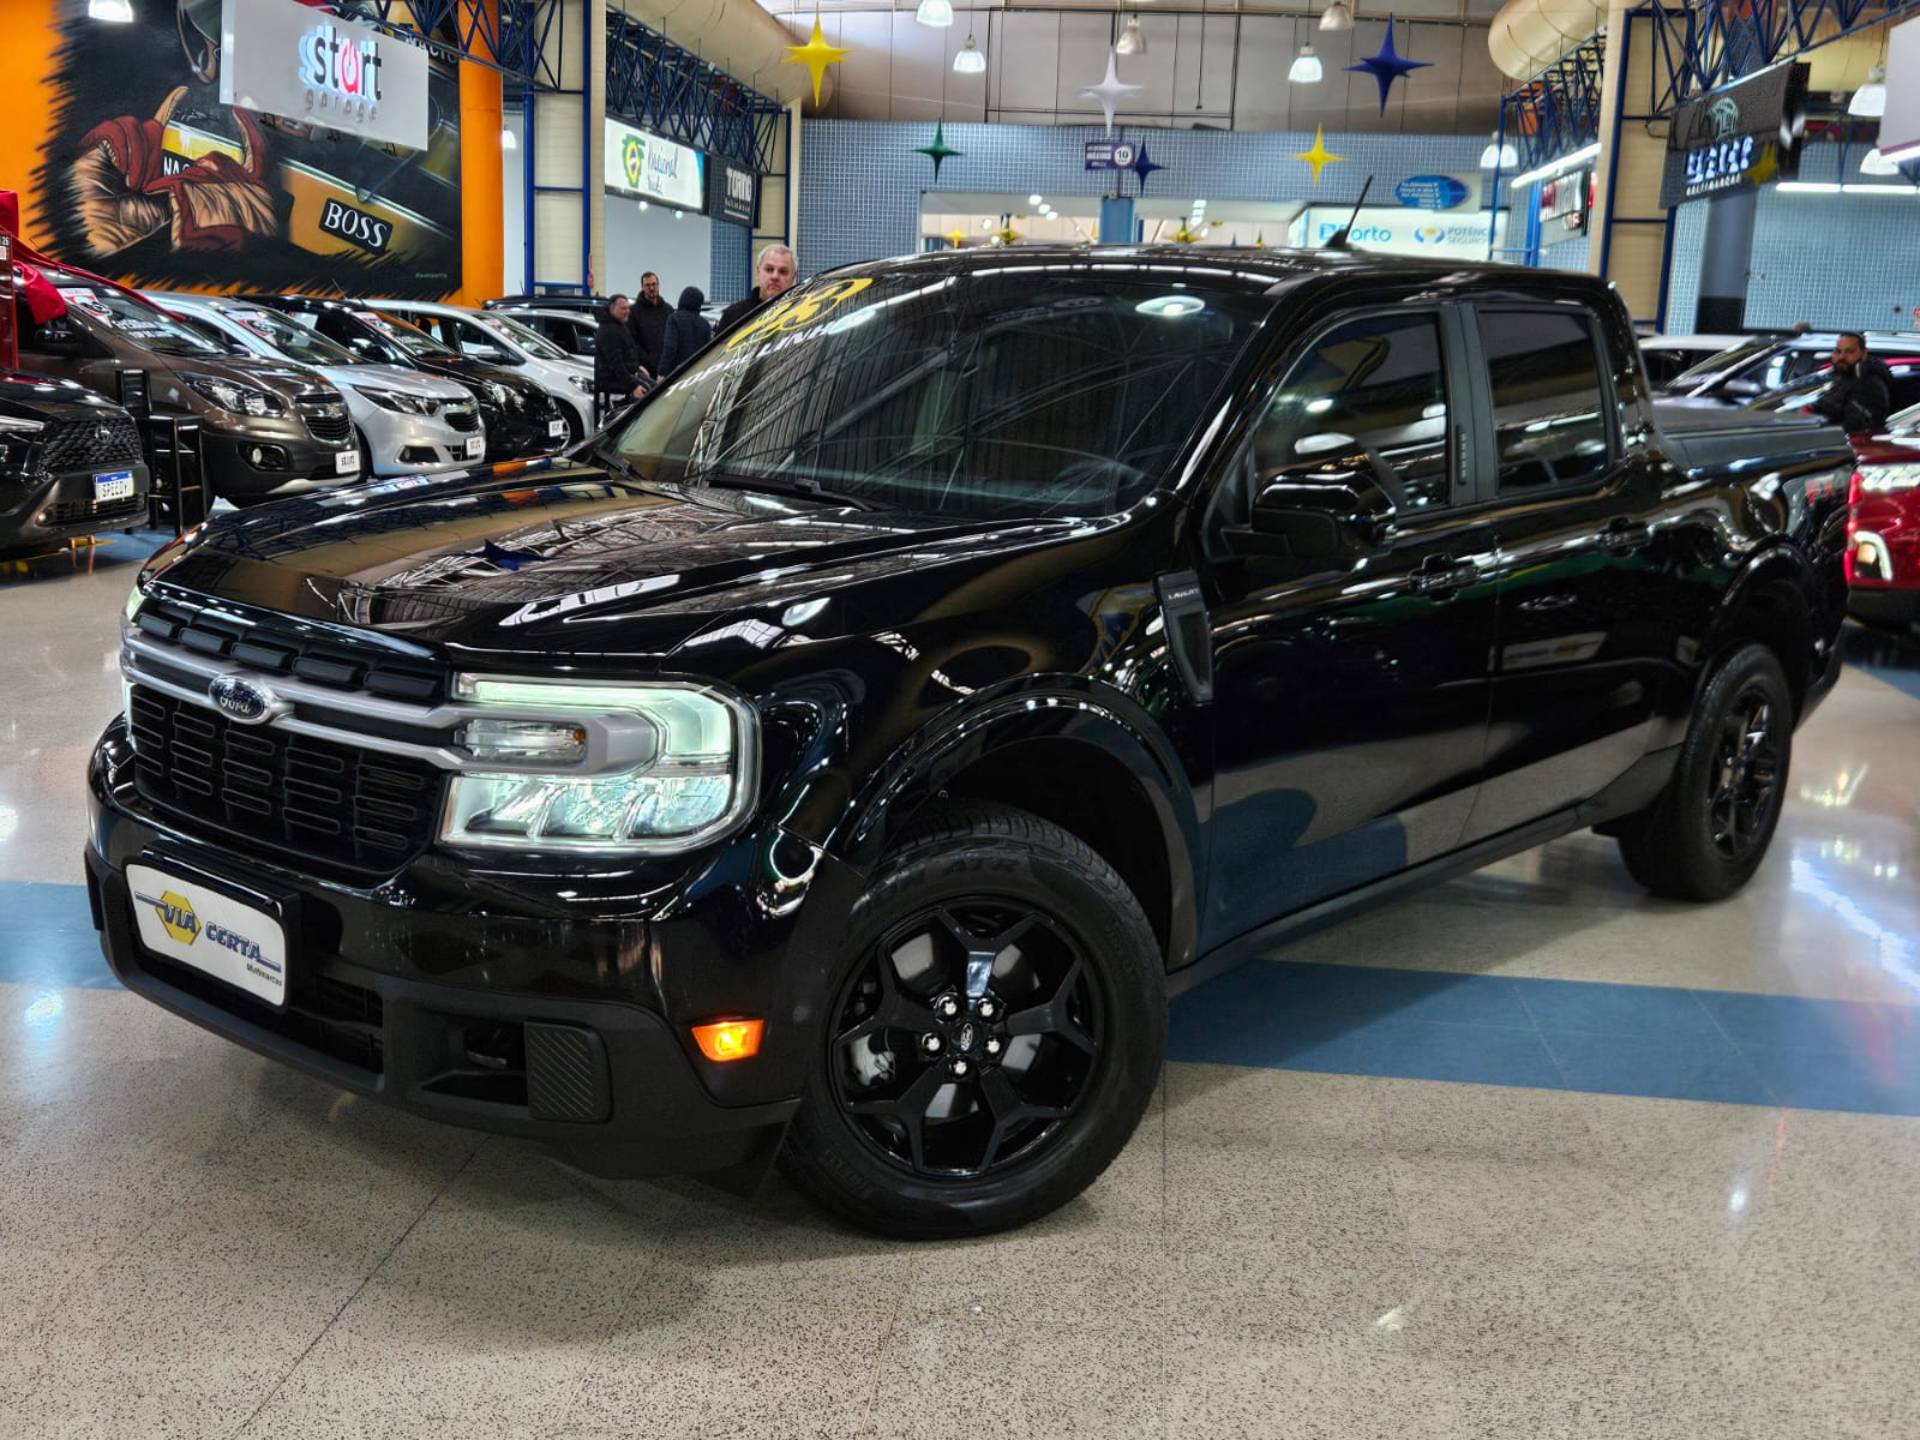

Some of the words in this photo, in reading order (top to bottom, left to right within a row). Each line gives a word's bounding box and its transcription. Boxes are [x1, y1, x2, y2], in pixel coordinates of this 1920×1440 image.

[303, 23, 382, 101] start
[324, 202, 388, 248] BOSS
[163, 904, 197, 934] VIA
[205, 920, 263, 962] CERTA
